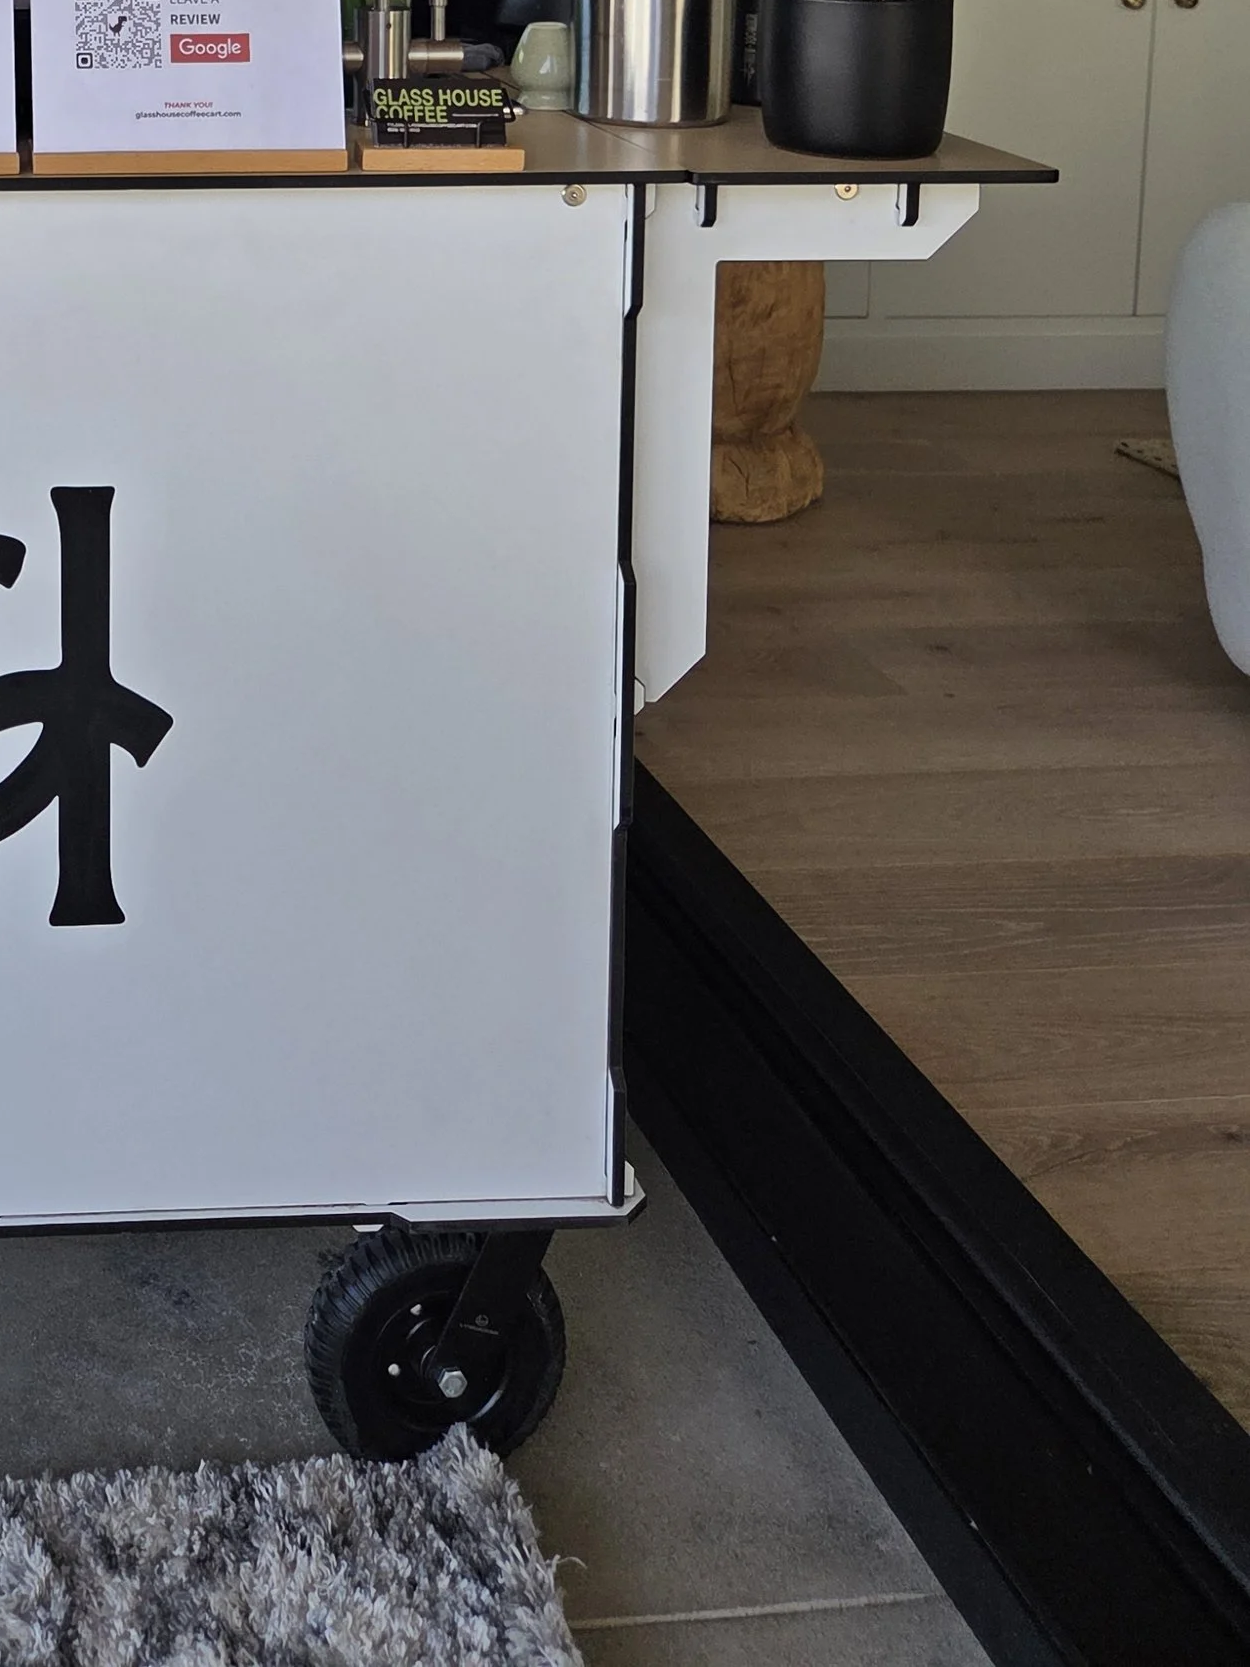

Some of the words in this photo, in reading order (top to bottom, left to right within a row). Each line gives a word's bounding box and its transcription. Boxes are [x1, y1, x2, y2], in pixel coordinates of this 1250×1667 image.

[170, 14, 221, 25] REVIEW
[178, 38, 242, 59] Google
[373, 88, 434, 106] GLASS
[438, 88, 504, 107] HOUSE
[135, 110, 242, 120] glasshousecoffeecart.com
[375, 105, 449, 123] COFFEE
